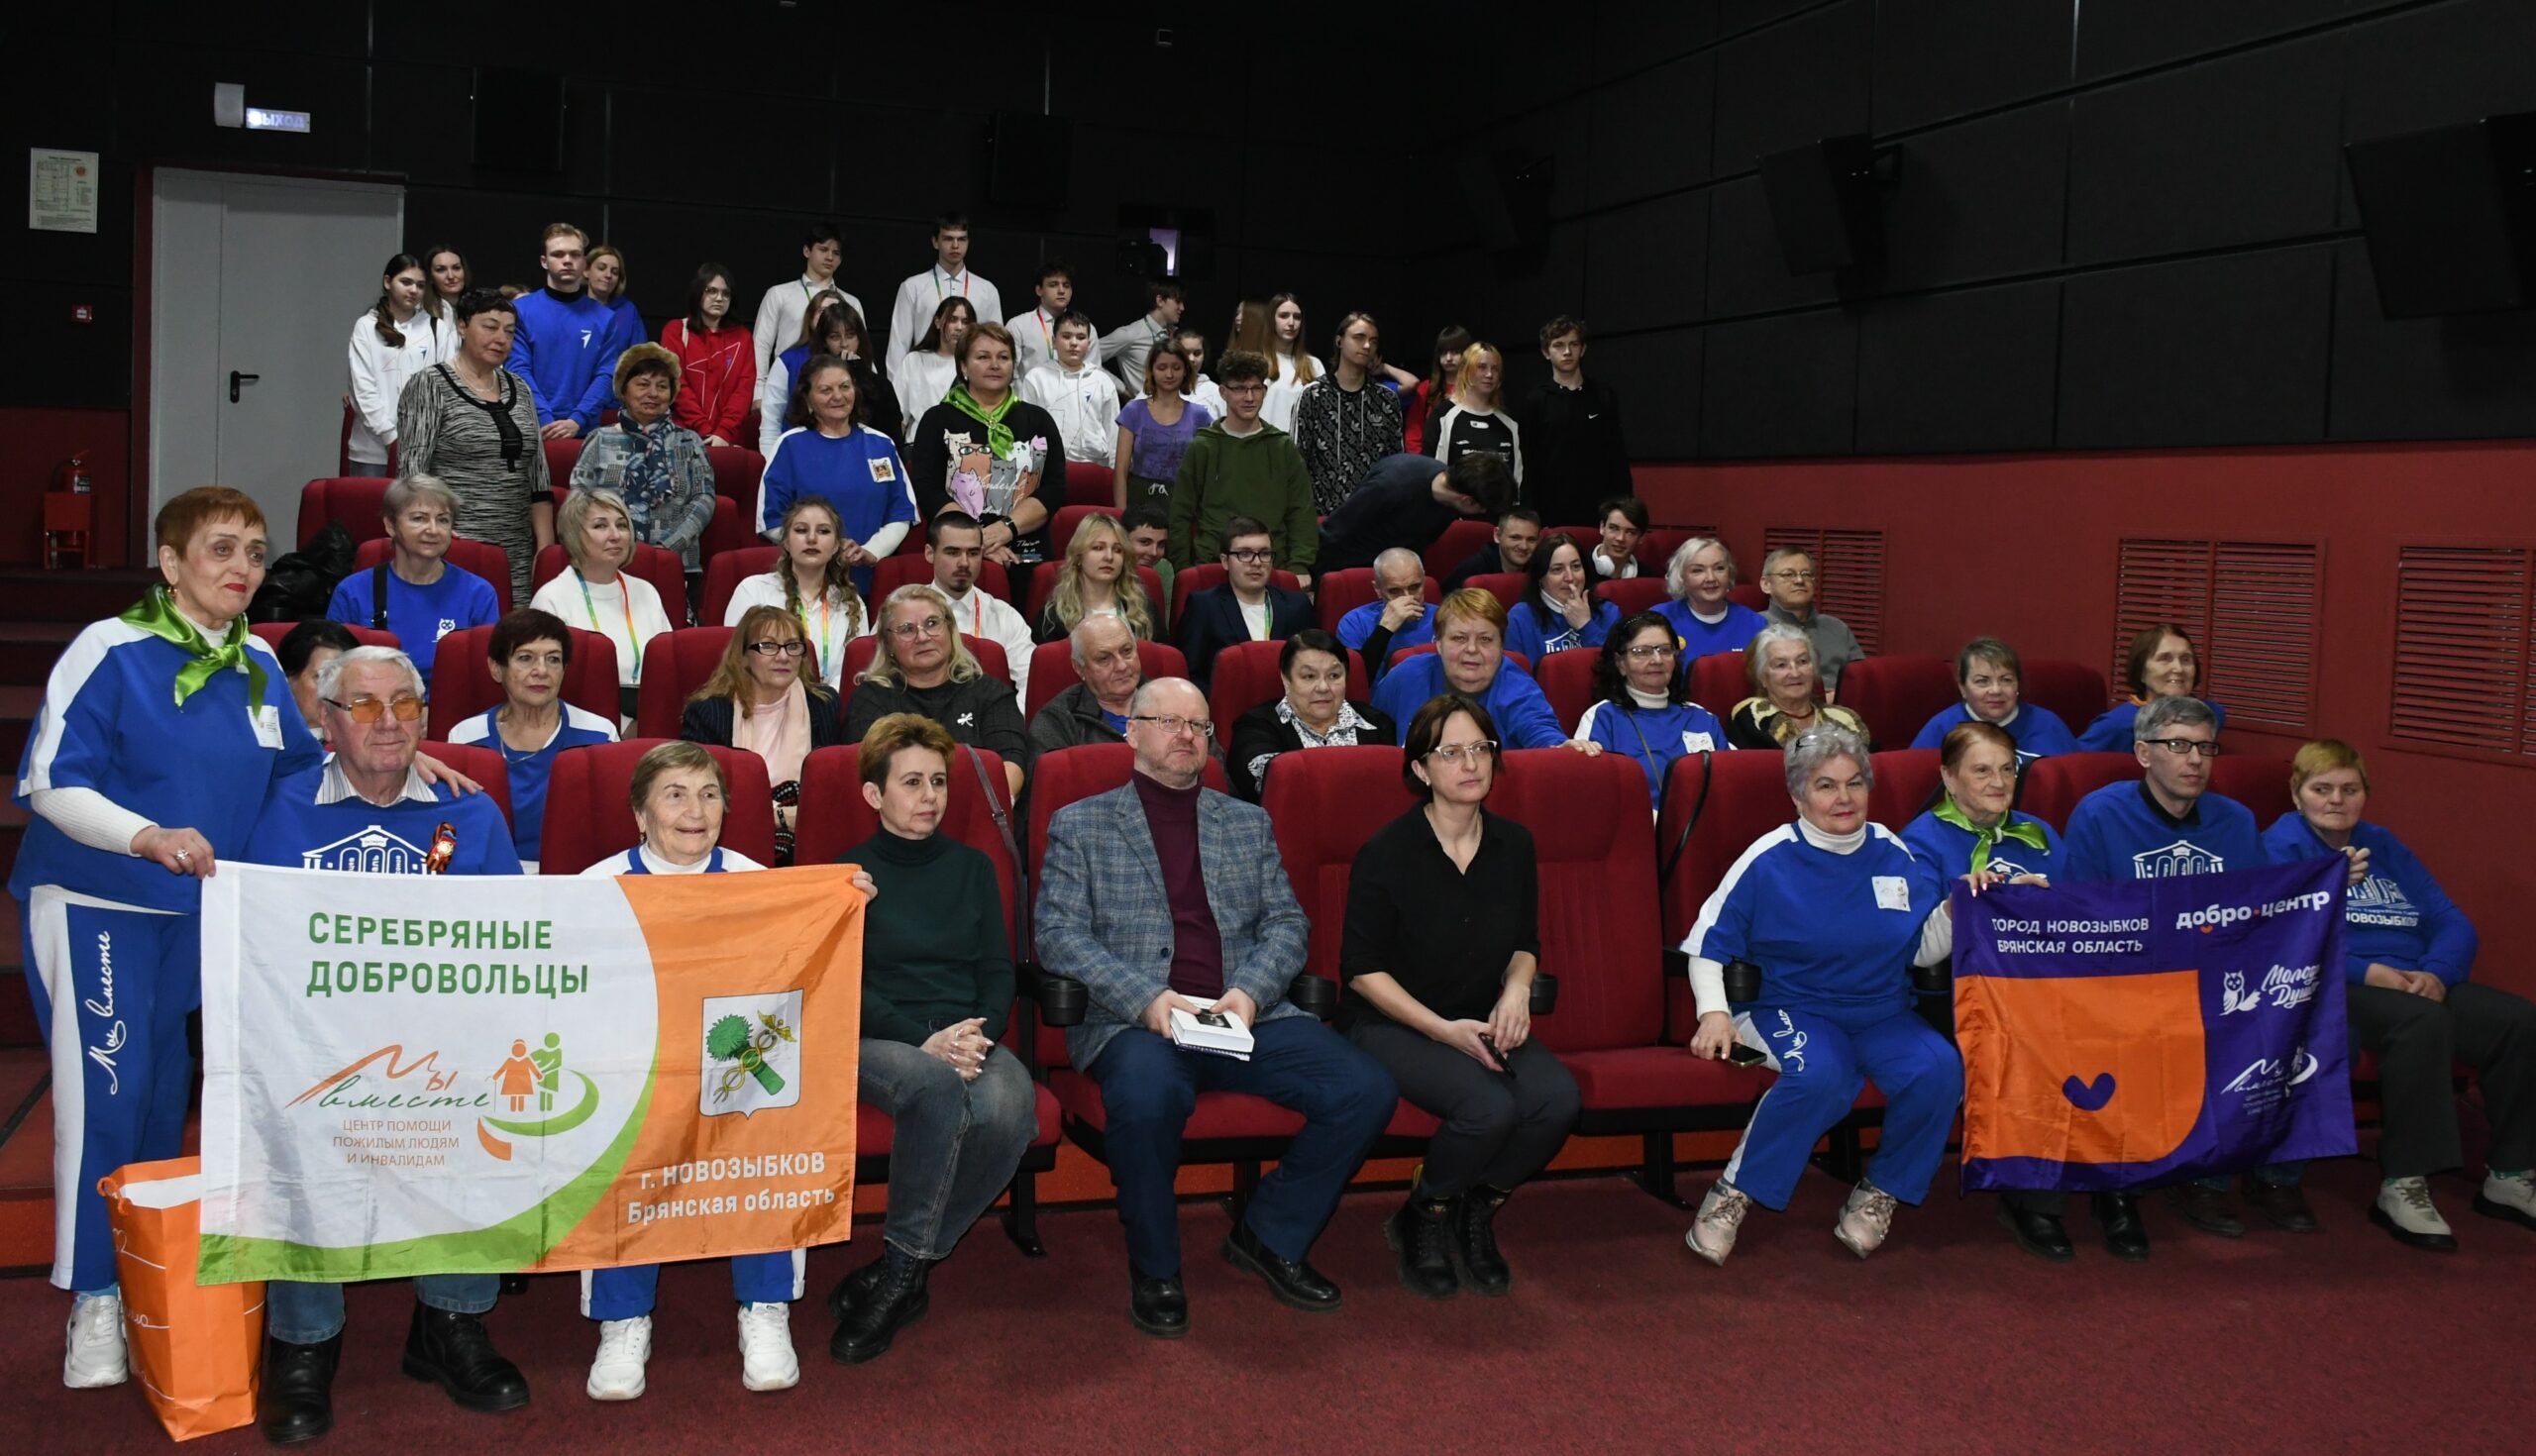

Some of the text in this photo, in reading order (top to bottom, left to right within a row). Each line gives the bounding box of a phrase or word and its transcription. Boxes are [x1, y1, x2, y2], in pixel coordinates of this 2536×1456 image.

[308, 911, 553, 950] СЕРЕБРЯНЫЕ
[1991, 918, 2150, 935] ГОРОД НОВОЗЫБКОВ
[1997, 939, 2144, 953] БРЯНСКАЯ ОБЛАСТЬ
[85, 931, 115, 1017] вместе
[306, 960, 588, 999] ДОБРОВОЛЬЦЫ
[285, 1044, 459, 1108] Мы
[319, 1074, 490, 1109] вместе
[333, 1137, 460, 1151] ПОЖИЛЫМ ЛЮДЯМ
[343, 1119, 452, 1133] ЦЕНТР ПОМОЩИ
[347, 1153, 446, 1167] И ИНВАЛИДАМ
[641, 1151, 825, 1190] г. НОВОЗЫБКОВ
[628, 1189, 835, 1226] Брянская область
